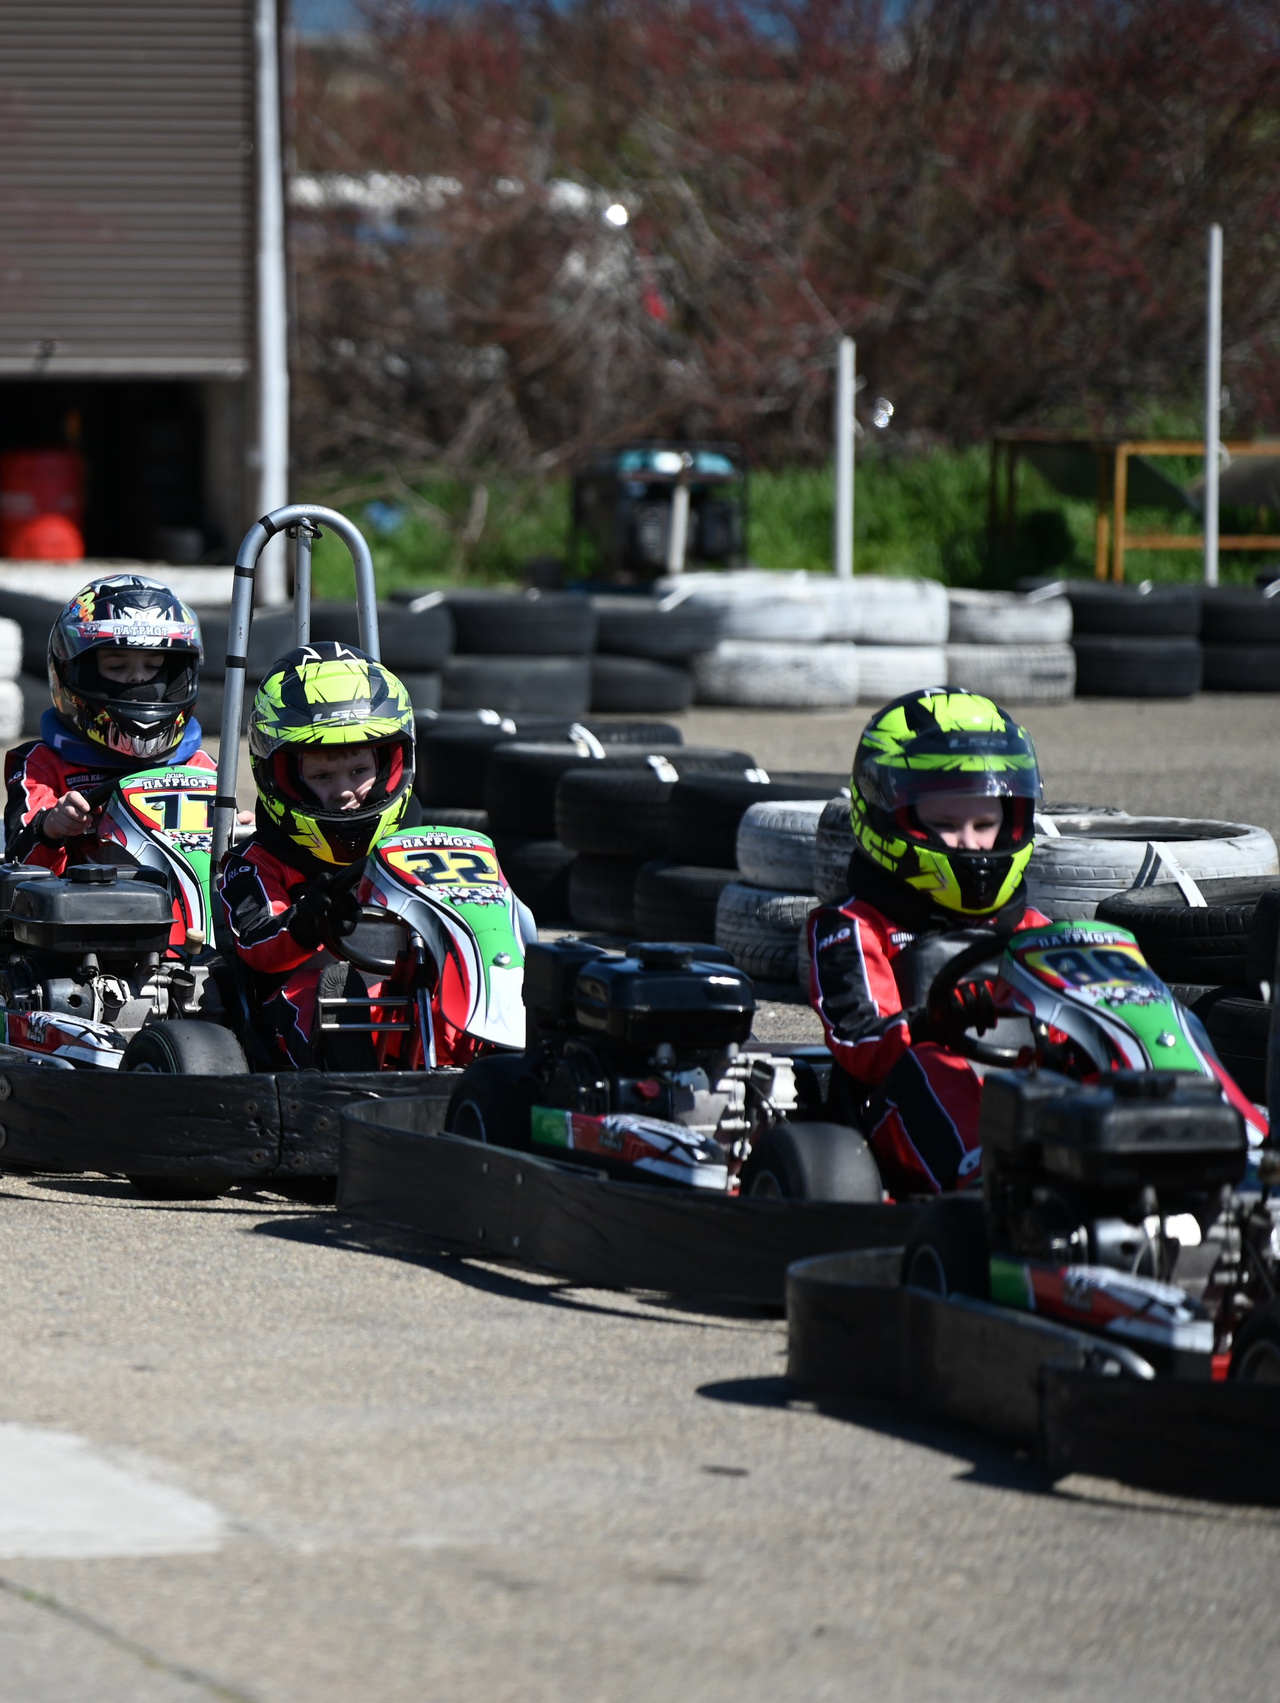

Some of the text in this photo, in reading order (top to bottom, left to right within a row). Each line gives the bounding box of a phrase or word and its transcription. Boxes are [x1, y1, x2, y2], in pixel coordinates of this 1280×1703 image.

[113, 625, 168, 636] ПАТРИОТ
[143, 777, 208, 790] ПАТРИОТ
[143, 794, 215, 829] 11
[401, 837, 473, 849] ПАТРИОТ
[406, 852, 499, 885] 22
[1038, 932, 1115, 948] ПАТРИОТ
